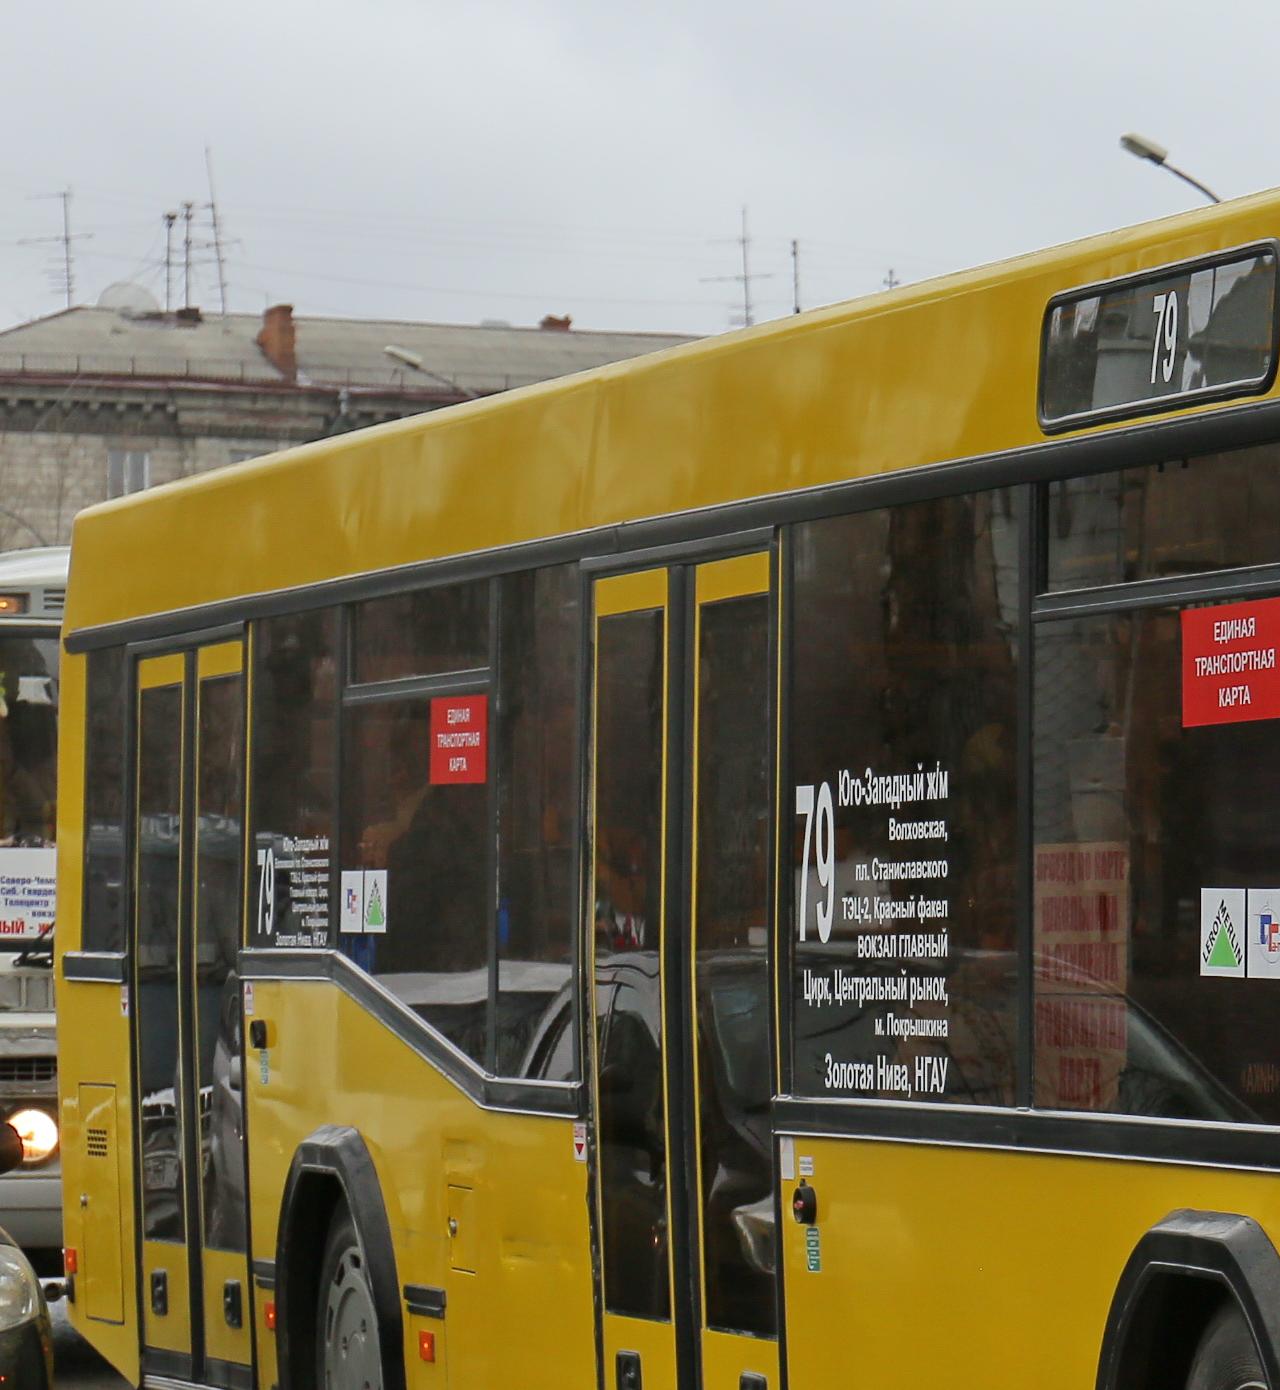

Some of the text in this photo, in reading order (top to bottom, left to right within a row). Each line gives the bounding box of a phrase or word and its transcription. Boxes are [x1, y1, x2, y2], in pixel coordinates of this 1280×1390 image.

[1150, 291, 1178, 384] 79
[1213, 617, 1256, 644] ЕДИНАЯ
[1195, 648, 1275, 677] ТРАНСПОРТНАЯ
[1218, 685, 1251, 708] КАРТА
[838, 761, 948, 809] Юго-Западный ж/м
[889, 818, 948, 842] Волховская,
[796, 781, 835, 944] 79
[856, 857, 948, 881] пл. Станиславского
[257, 847, 274, 935] 79
[841, 895, 948, 922] ТЭЦ-2, Красный факел
[857, 928, 948, 959] ВОКЗАЛ ГЛАВНЫЙ
[1203, 911, 1222, 963] LEROY
[1218, 899, 1243, 965] MERLIN
[803, 967, 949, 1009] Цирк, Центральный рынок,
[875, 1012, 948, 1041] м. Покрышкина
[824, 1053, 949, 1098] Золотая Нива, НГАУ
